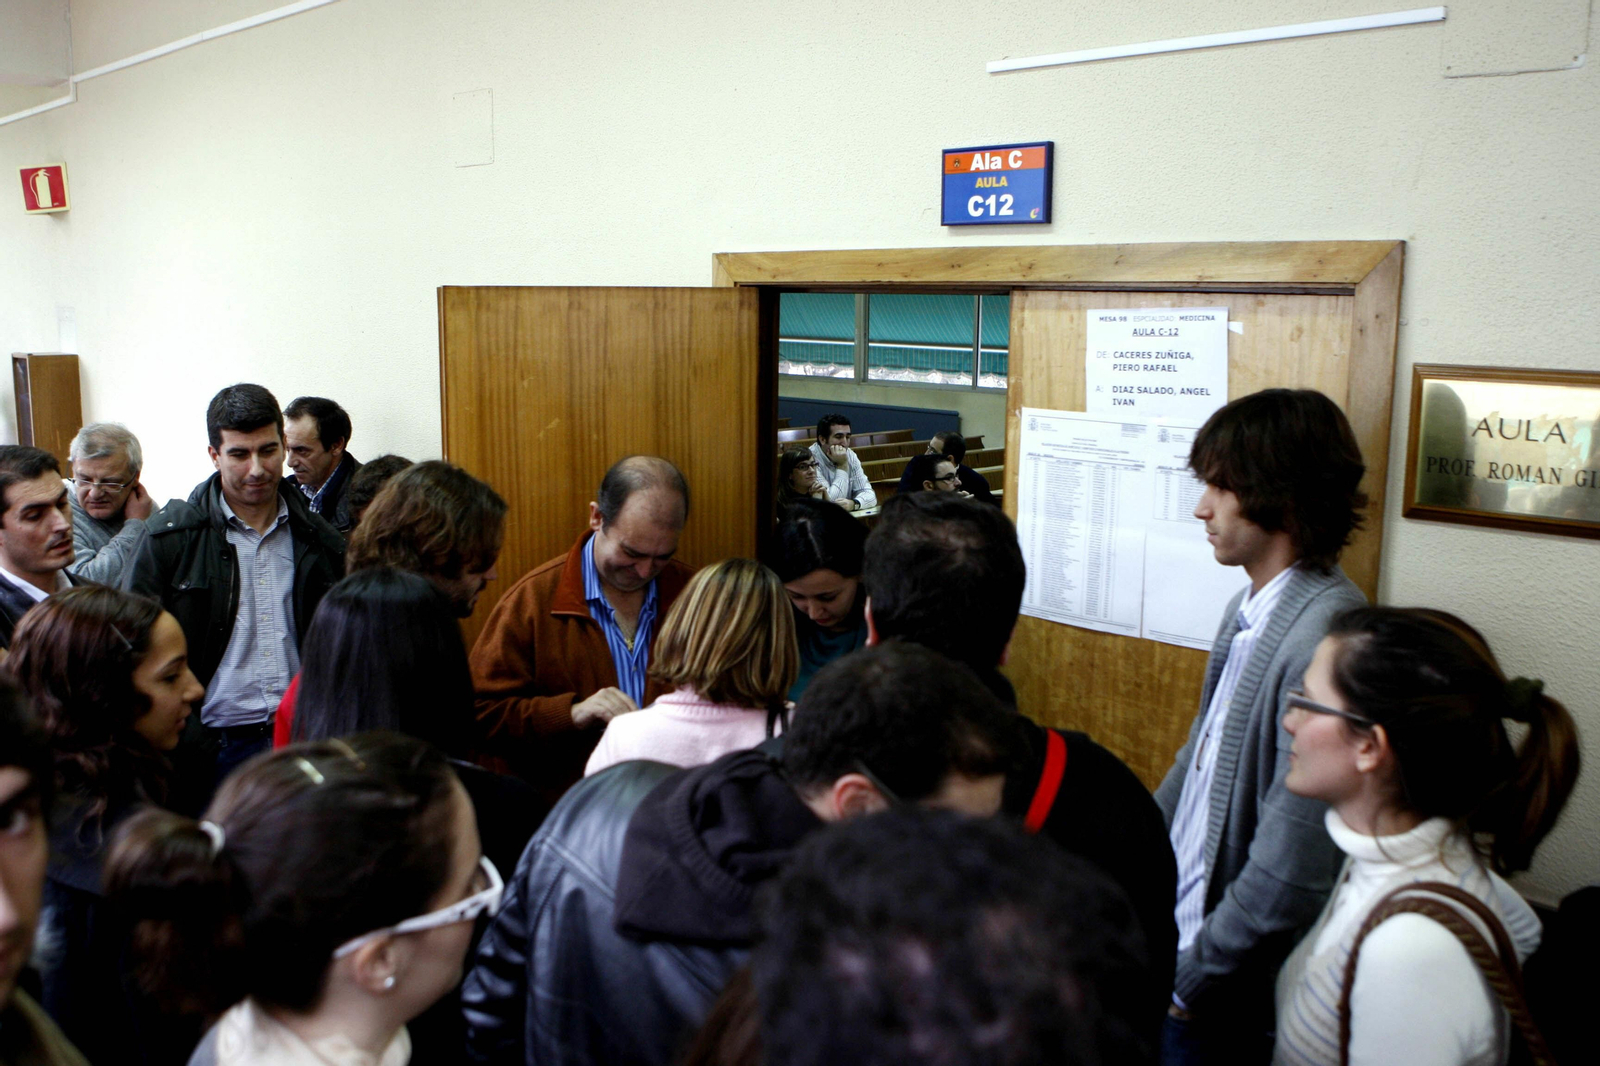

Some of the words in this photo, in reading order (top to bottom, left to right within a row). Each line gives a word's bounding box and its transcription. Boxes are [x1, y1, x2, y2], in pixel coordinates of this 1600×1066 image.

[970, 153, 1002, 171] Ala
[1008, 150, 1023, 168] C
[975, 176, 1008, 188] AULA
[967, 194, 1014, 217] C12
[1132, 328, 1155, 336] AULA
[1158, 327, 1179, 336] C-12
[1113, 351, 1152, 359] CACERES
[1155, 350, 1194, 361] ZUÑIGA,
[1113, 363, 1140, 372] PIERO
[1143, 364, 1178, 372] RAFAEL
[1112, 385, 1134, 394] DIAZ
[1137, 386, 1177, 396] SALADO,
[1180, 387, 1211, 396] ANGEL
[1112, 398, 1135, 406] IVAN
[1471, 417, 1567, 444] AULA
[1488, 461, 1563, 485] ROMAN
[1574, 469, 1600, 489] GI
